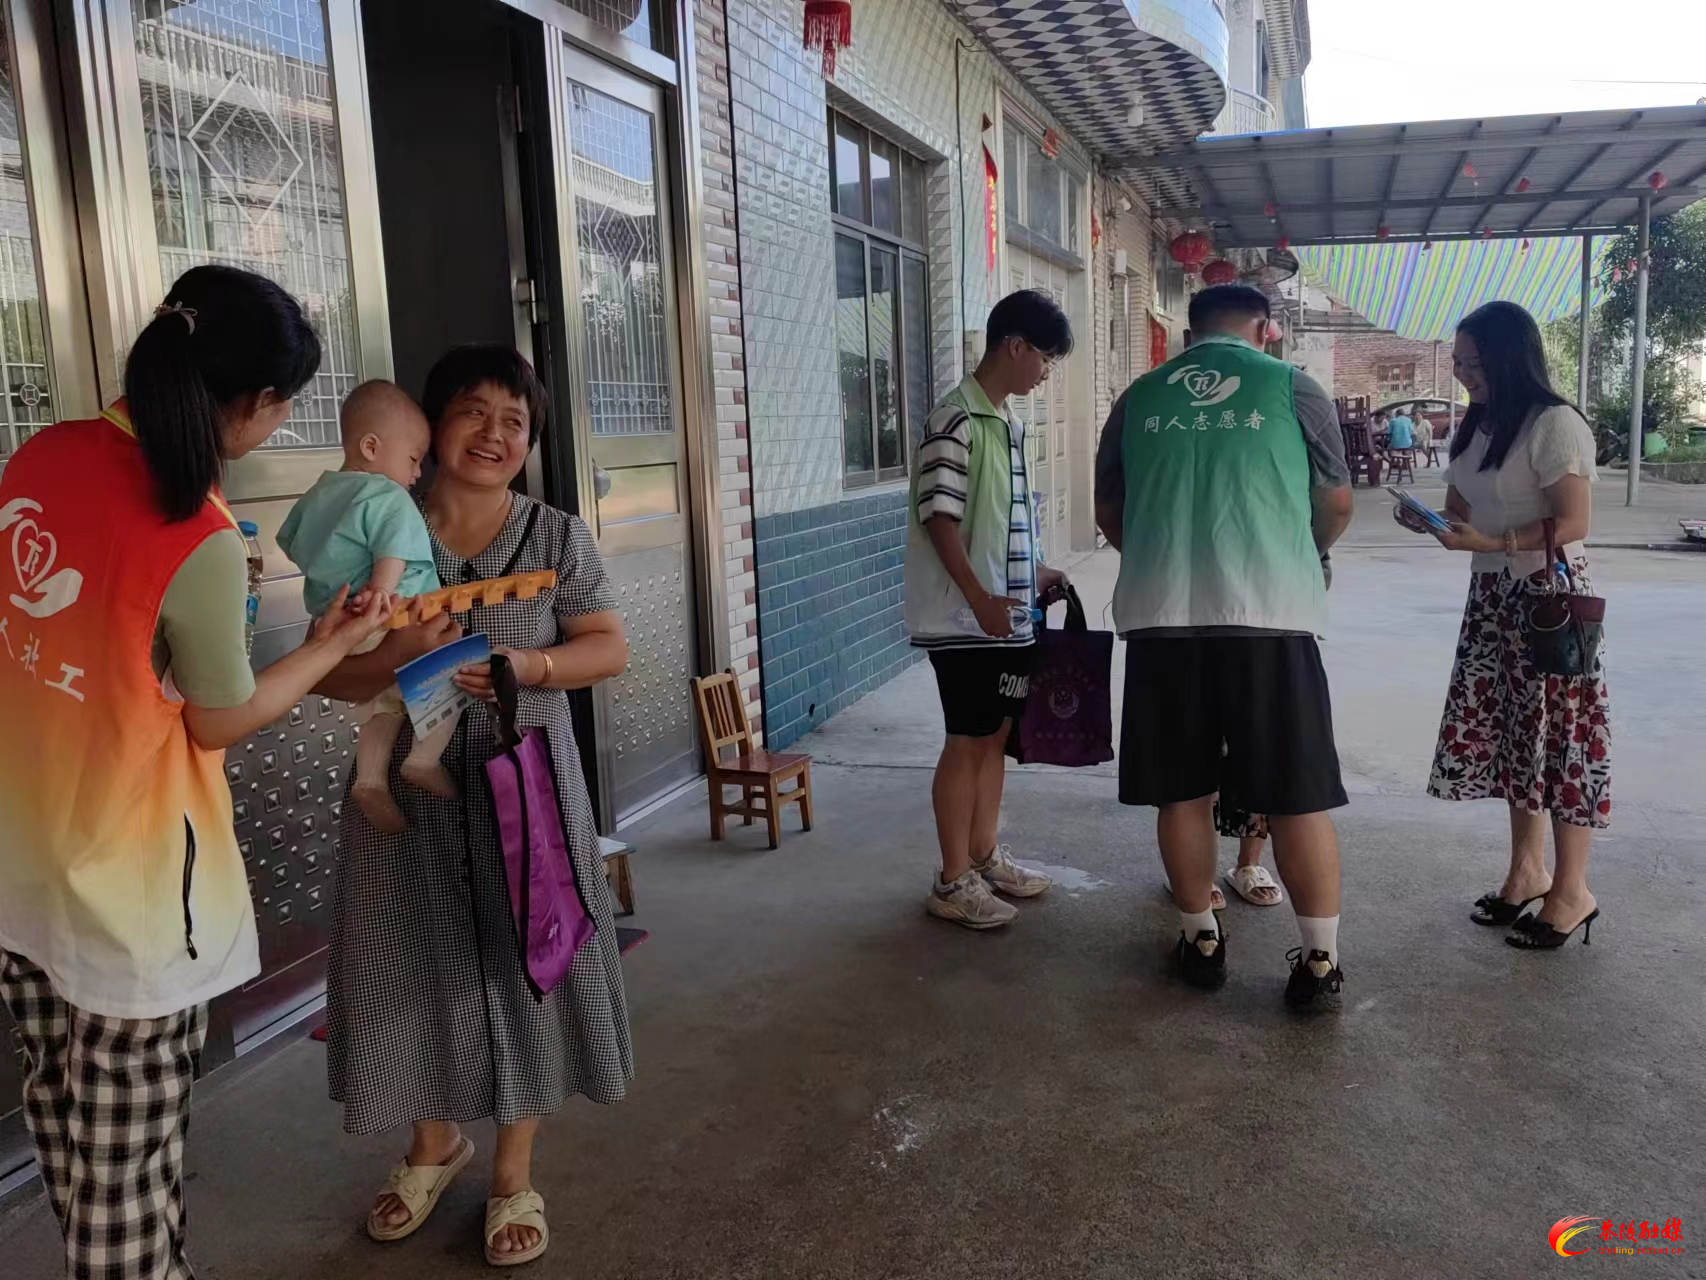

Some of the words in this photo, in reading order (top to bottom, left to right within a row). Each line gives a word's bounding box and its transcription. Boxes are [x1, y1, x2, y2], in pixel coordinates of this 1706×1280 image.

[1144, 409, 1266, 433] 同人志愿者
